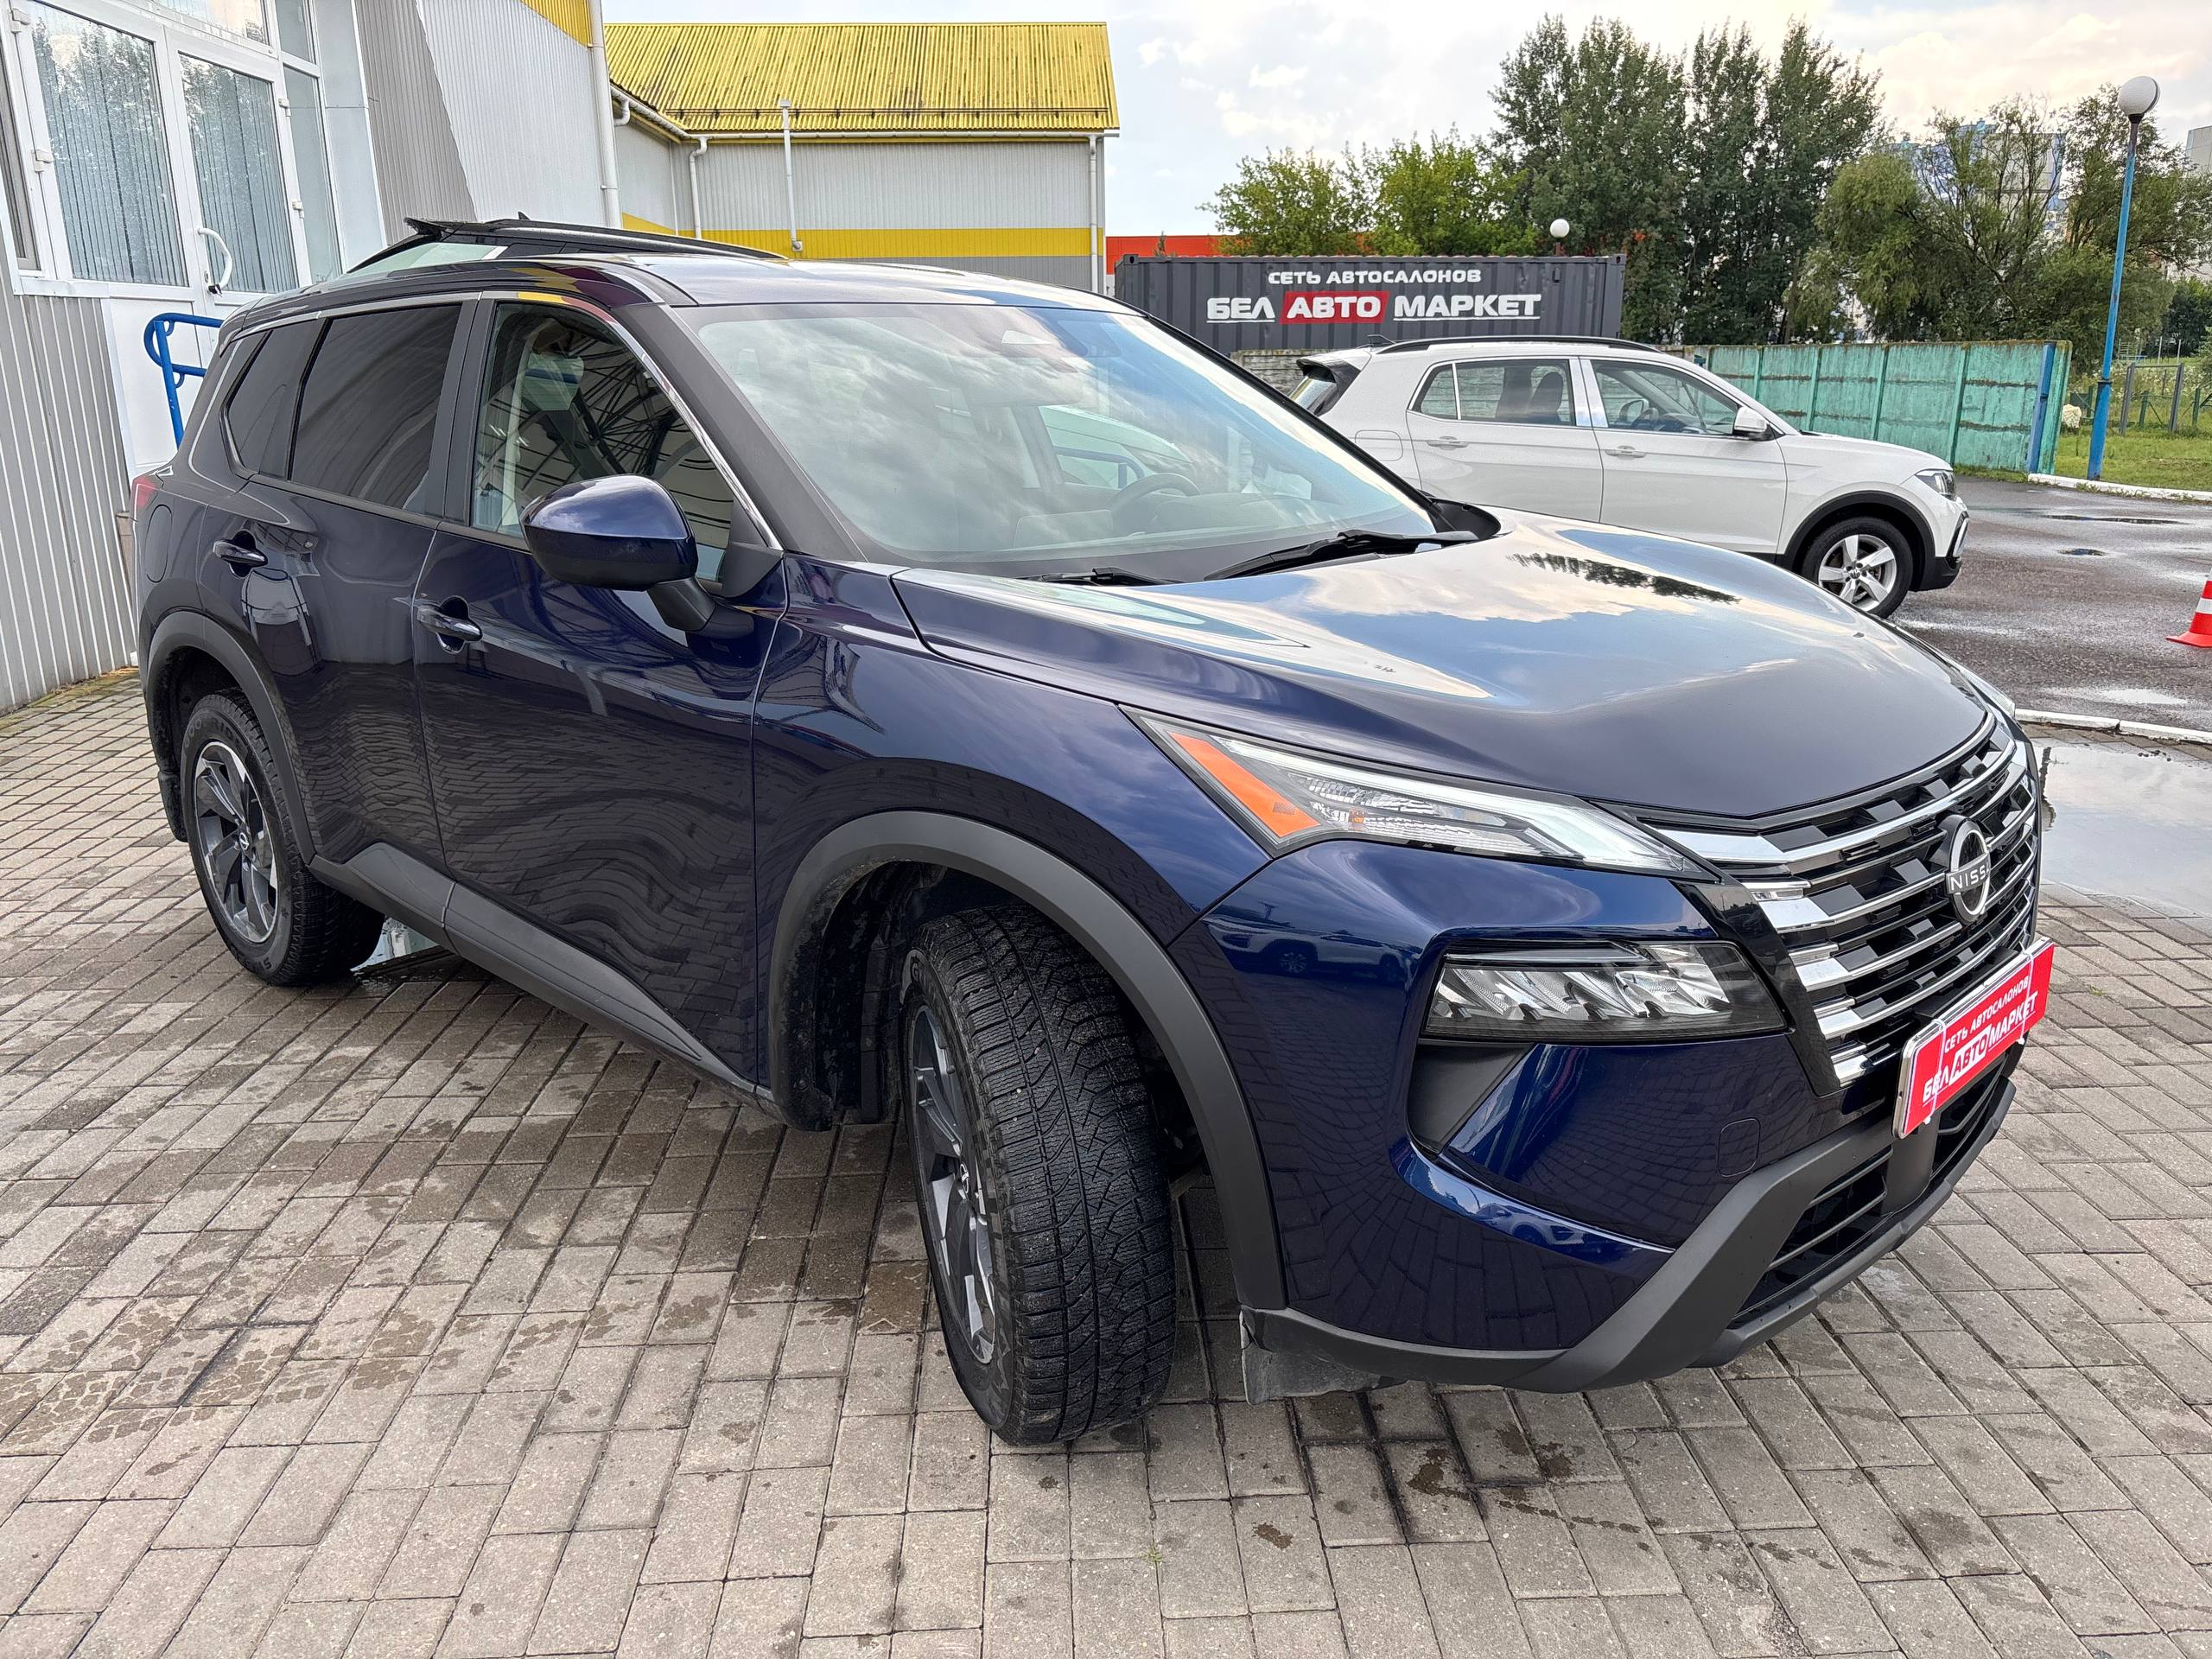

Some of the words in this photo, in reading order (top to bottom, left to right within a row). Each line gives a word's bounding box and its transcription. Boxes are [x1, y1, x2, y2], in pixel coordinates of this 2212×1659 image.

[1268, 271, 1320, 284] СЕТЬ
[1326, 270, 1481, 284] АВТОСАЛОНОВ
[1207, 296, 1275, 320] БЕЛ
[1287, 296, 1381, 319] АВТО
[1394, 294, 1541, 318] МАРКЕТ
[1944, 1027, 1968, 1053] СЕТЬ
[1970, 976, 2029, 1033] АВТОСАЛОНОВ
[1953, 1033, 1987, 1078] АВТО
[1988, 990, 2038, 1048] МАРКЕТ
